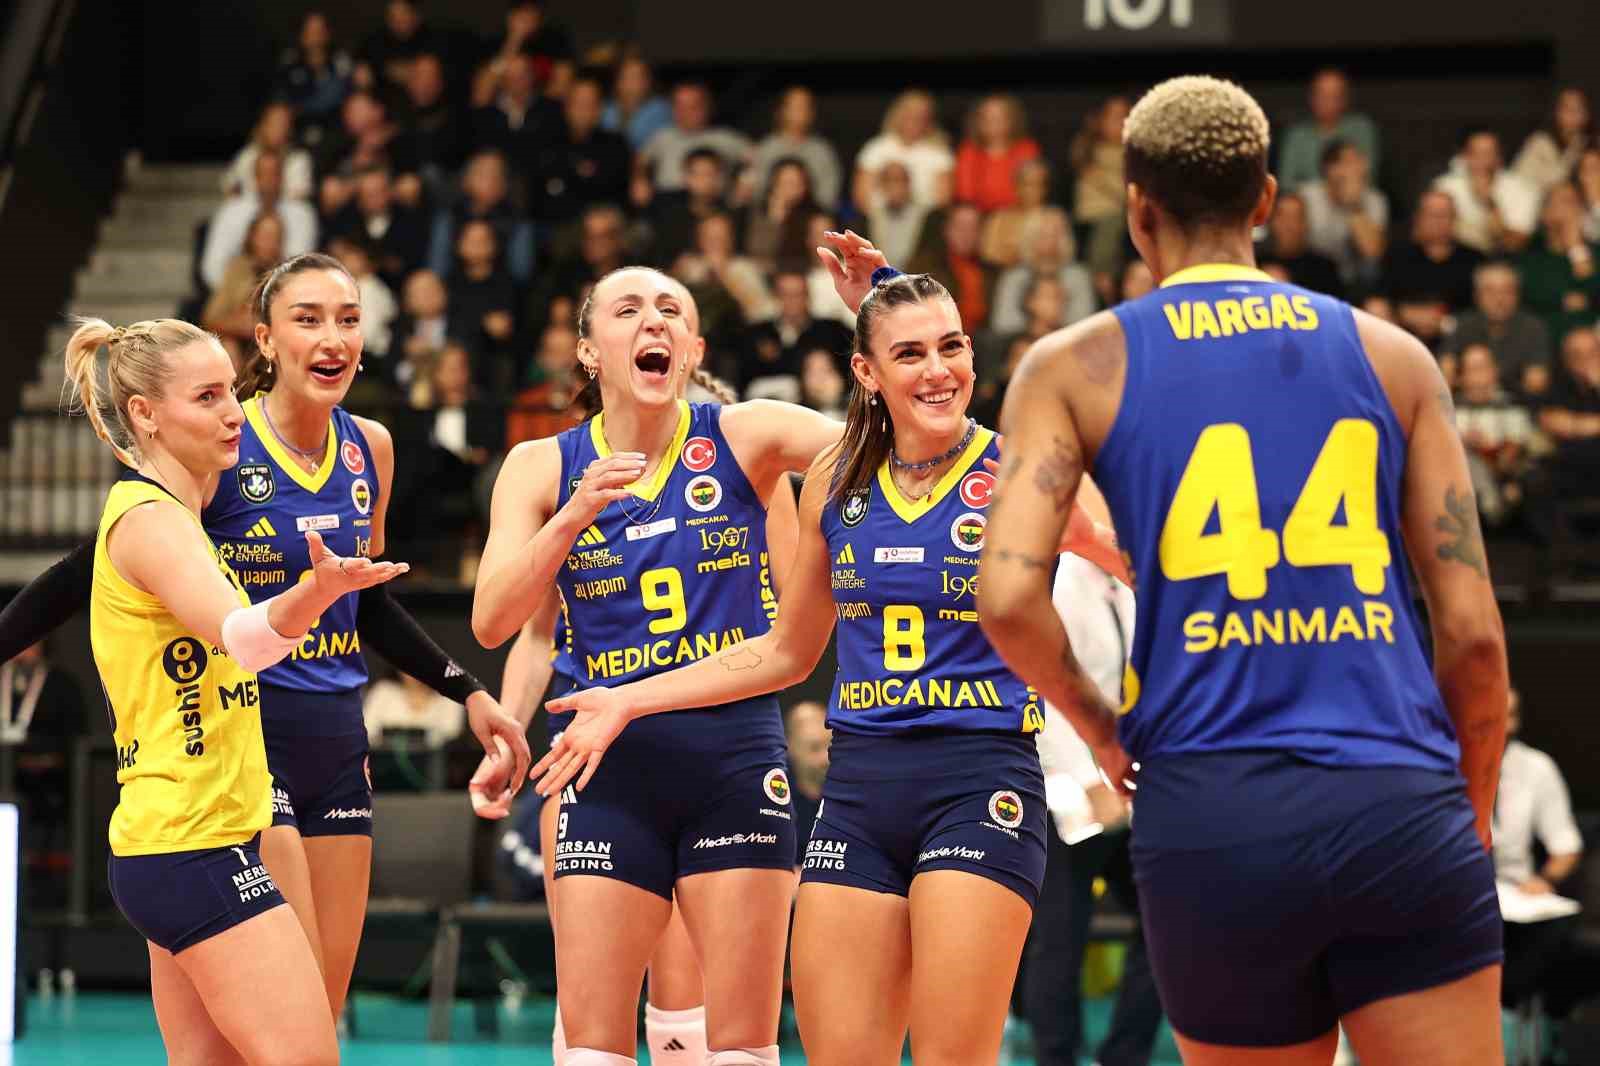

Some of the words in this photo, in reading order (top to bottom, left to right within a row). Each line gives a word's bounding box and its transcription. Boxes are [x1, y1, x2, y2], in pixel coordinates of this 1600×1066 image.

[1163, 294, 1319, 340] VARGAS
[1159, 418, 1393, 601] 44
[236, 543, 271, 554] YILDIZ
[236, 552, 283, 563] ENTEGRE
[578, 547, 611, 561] YILDIZ
[581, 554, 624, 570] ENTEGRE
[697, 552, 751, 574] mefa
[943, 556, 983, 567] MEDICAN
[639, 566, 687, 635] 9
[938, 608, 980, 623] me
[882, 604, 927, 671] 8
[1183, 600, 1396, 654] SANMAR
[558, 812, 569, 840] 9
